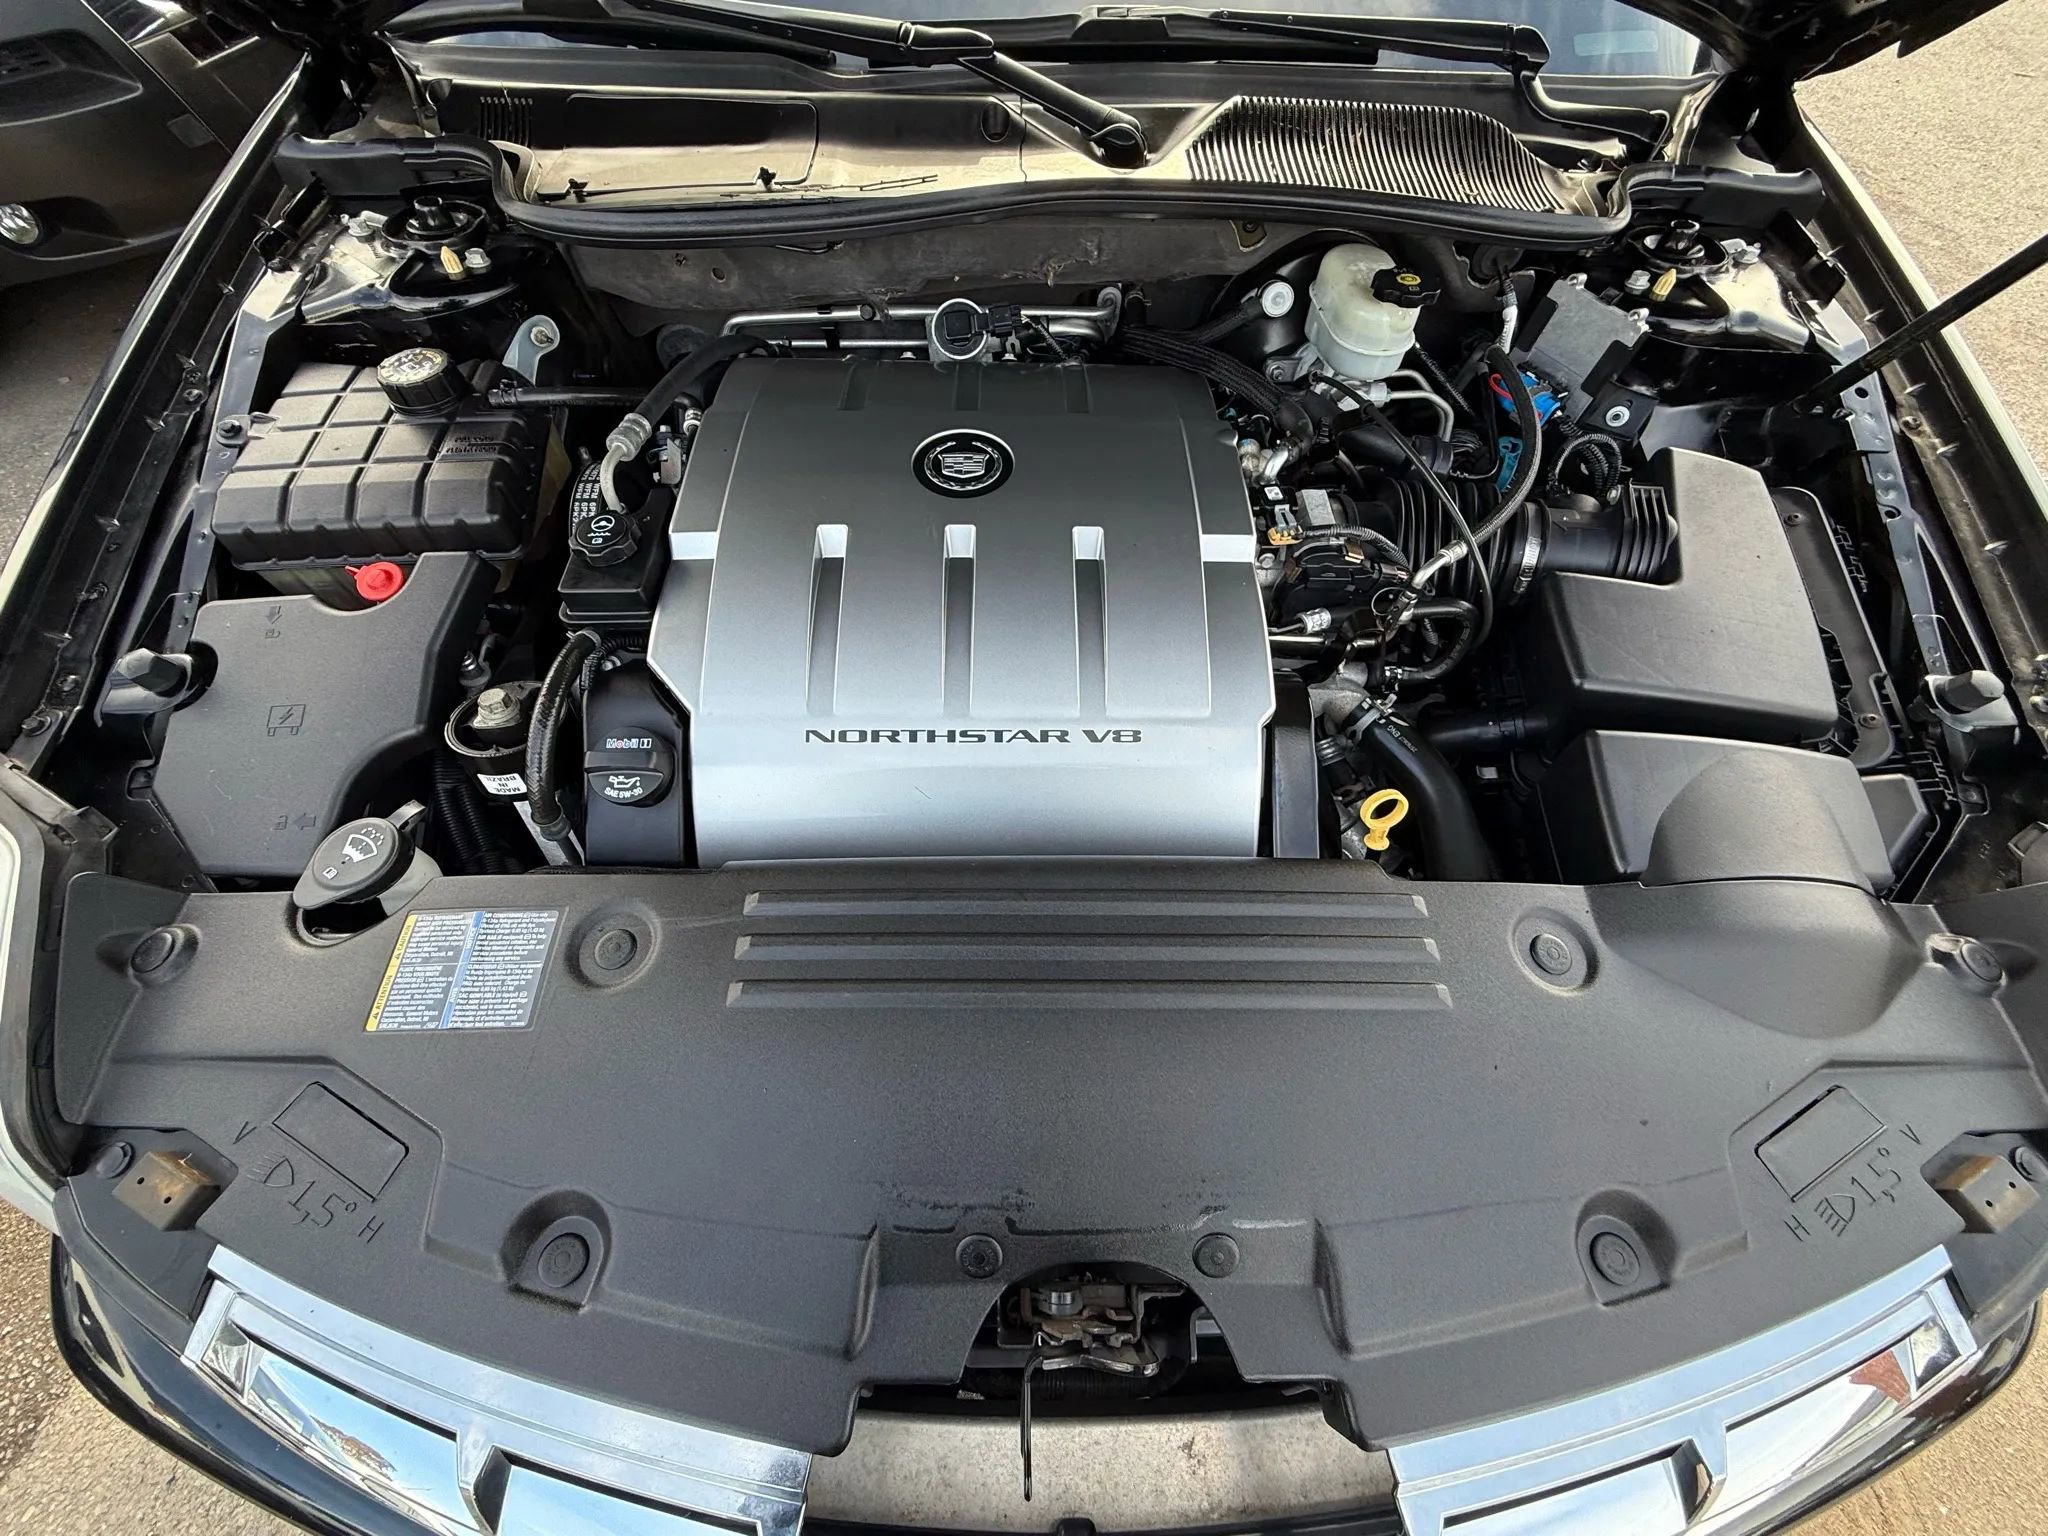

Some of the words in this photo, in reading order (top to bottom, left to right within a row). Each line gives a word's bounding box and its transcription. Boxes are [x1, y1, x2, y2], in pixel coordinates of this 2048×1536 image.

[606, 738, 639, 749] Mobil
[804, 728, 1071, 744] NORTHSTAR
[1081, 728, 1143, 744] V8
[604, 787, 619, 798] SAE
[618, 787, 643, 799] 5W-30
[397, 924, 412, 951] CAUTION
[375, 975, 392, 1010] ATTENTION
[357, 1215, 385, 1244] H
[1783, 1214, 1812, 1242] H
